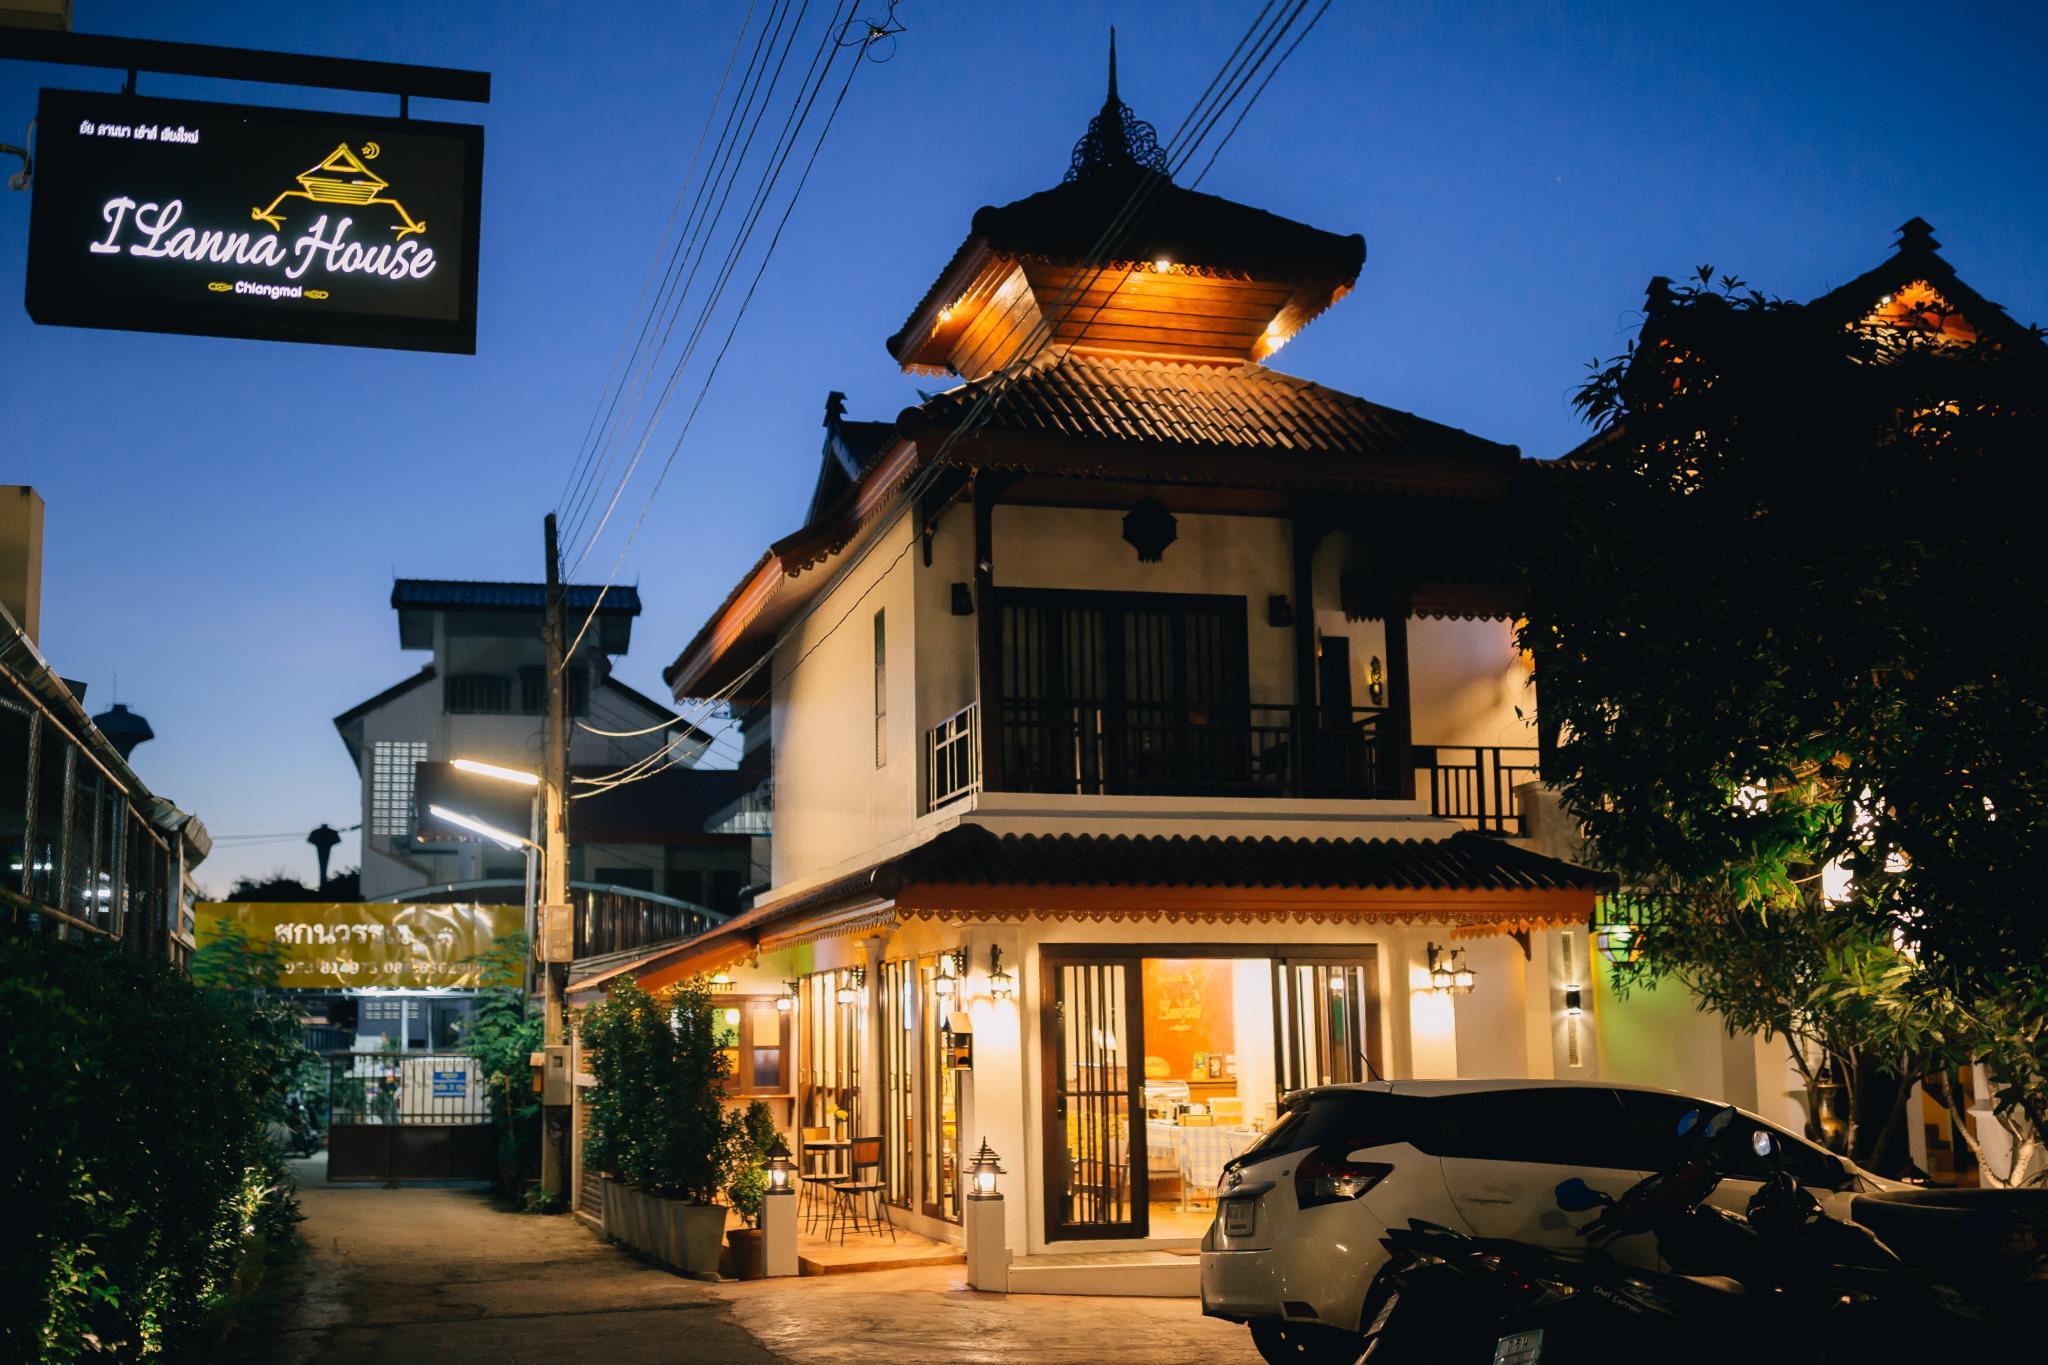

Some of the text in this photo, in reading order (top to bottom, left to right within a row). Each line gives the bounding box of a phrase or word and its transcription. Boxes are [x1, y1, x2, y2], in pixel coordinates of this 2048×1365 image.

[160, 126, 200, 145] เชียงใหม่
[130, 199, 287, 267] Lanna
[284, 214, 437, 280] House
[234, 280, 303, 300] Chiangmai
